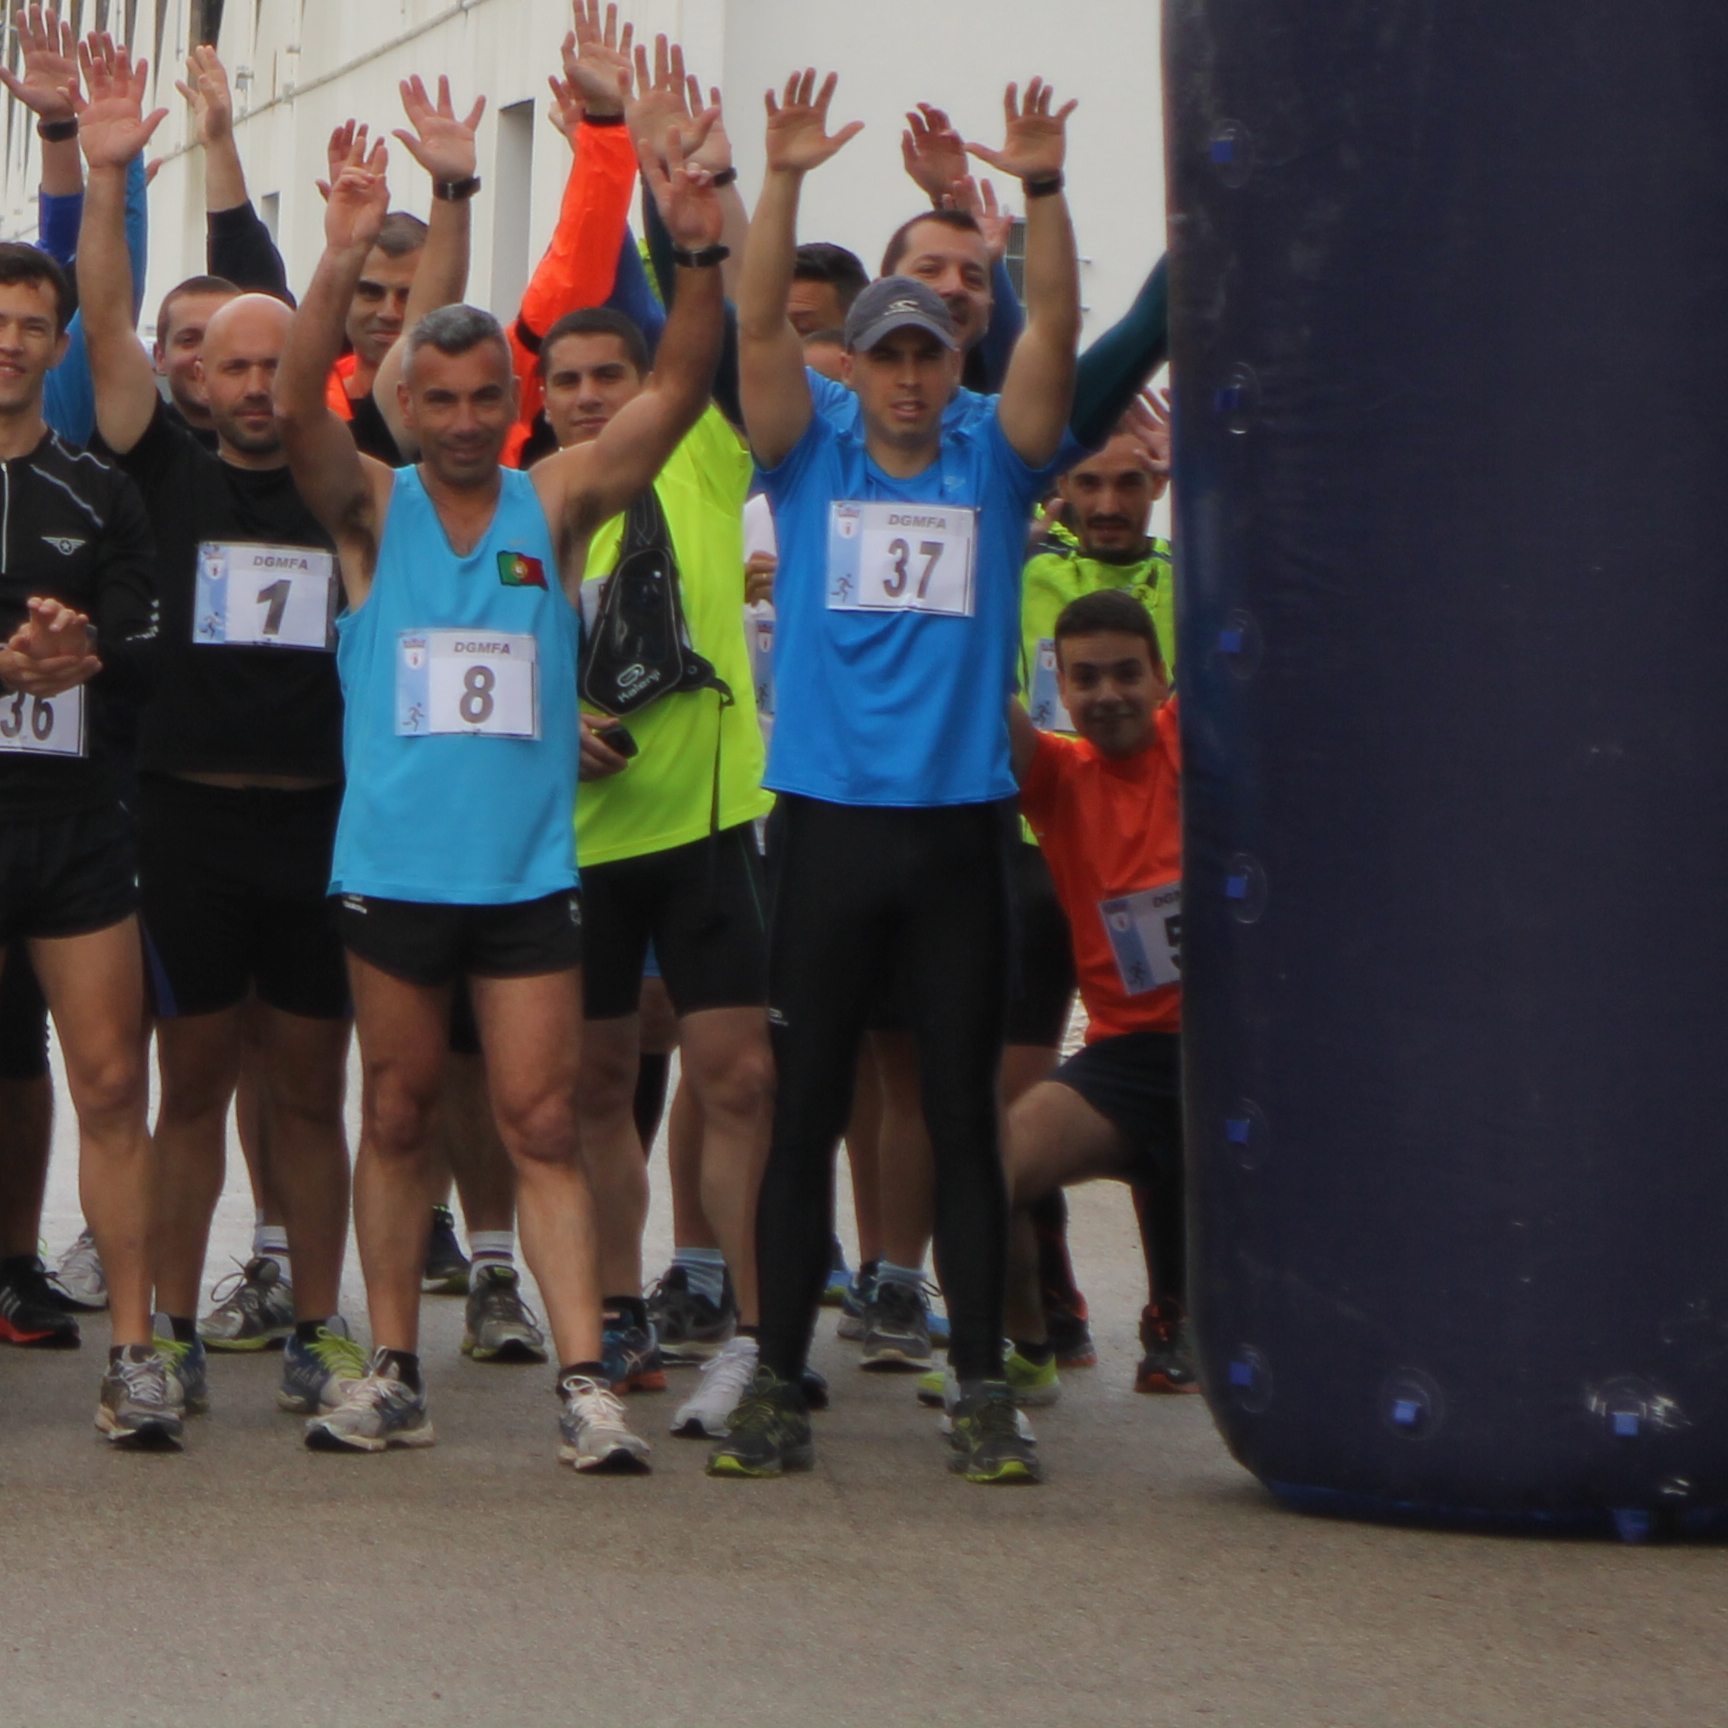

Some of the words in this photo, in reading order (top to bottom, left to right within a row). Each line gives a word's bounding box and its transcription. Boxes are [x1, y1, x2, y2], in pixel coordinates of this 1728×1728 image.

[888, 514, 947, 530] DGMFA
[253, 555, 309, 570] DGMFA
[882, 538, 945, 599] 37
[256, 579, 292, 635] 1
[454, 641, 511, 655] DGMFA
[0, 690, 54, 741] 36
[459, 665, 496, 724] 8
